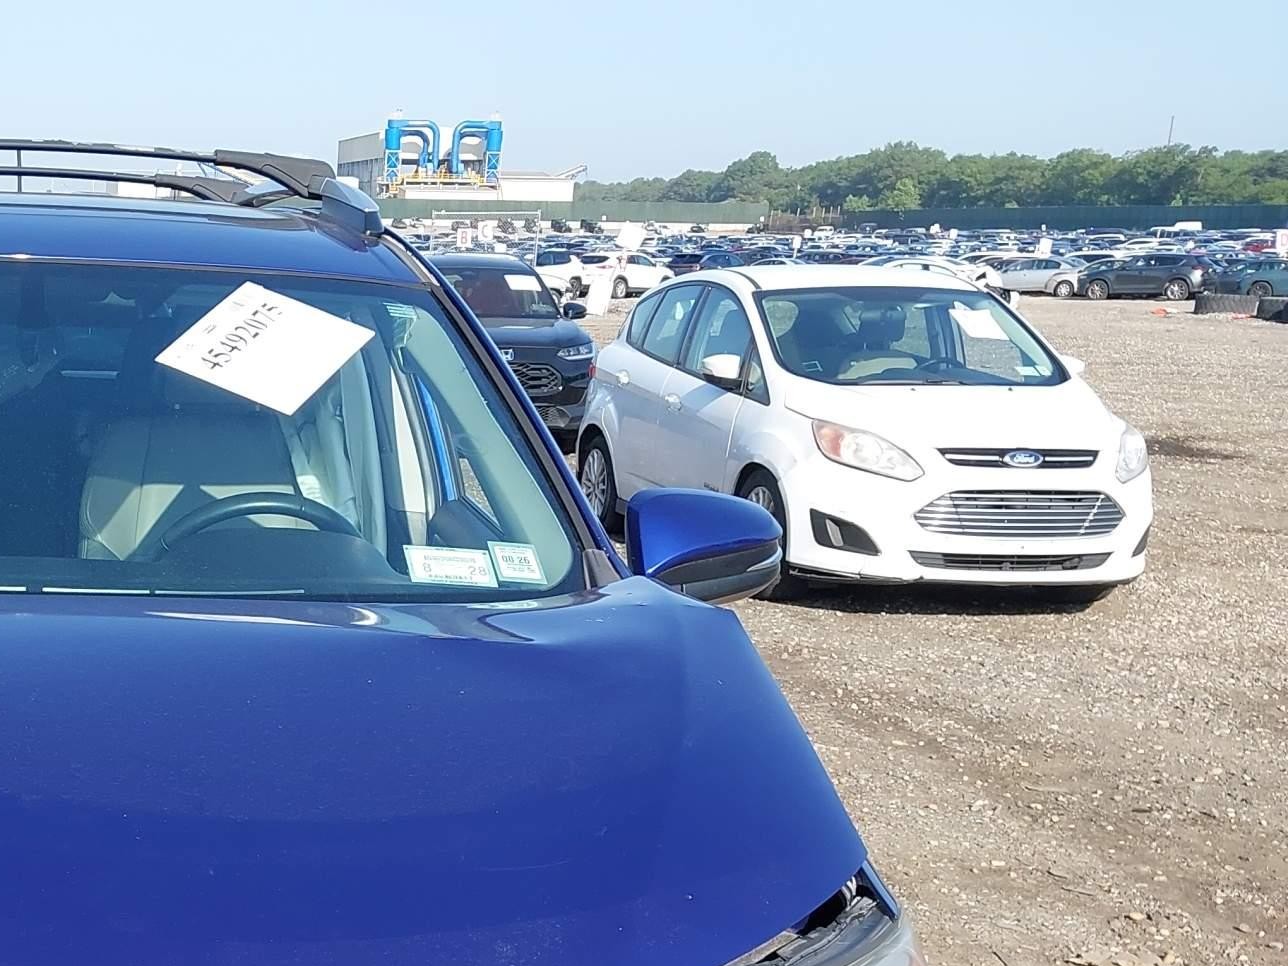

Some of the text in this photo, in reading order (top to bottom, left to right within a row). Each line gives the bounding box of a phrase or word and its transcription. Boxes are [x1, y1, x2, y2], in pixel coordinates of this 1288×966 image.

[460, 230, 467, 244] B
[201, 303, 283, 369] 45492075
[467, 565, 488, 577] 28
